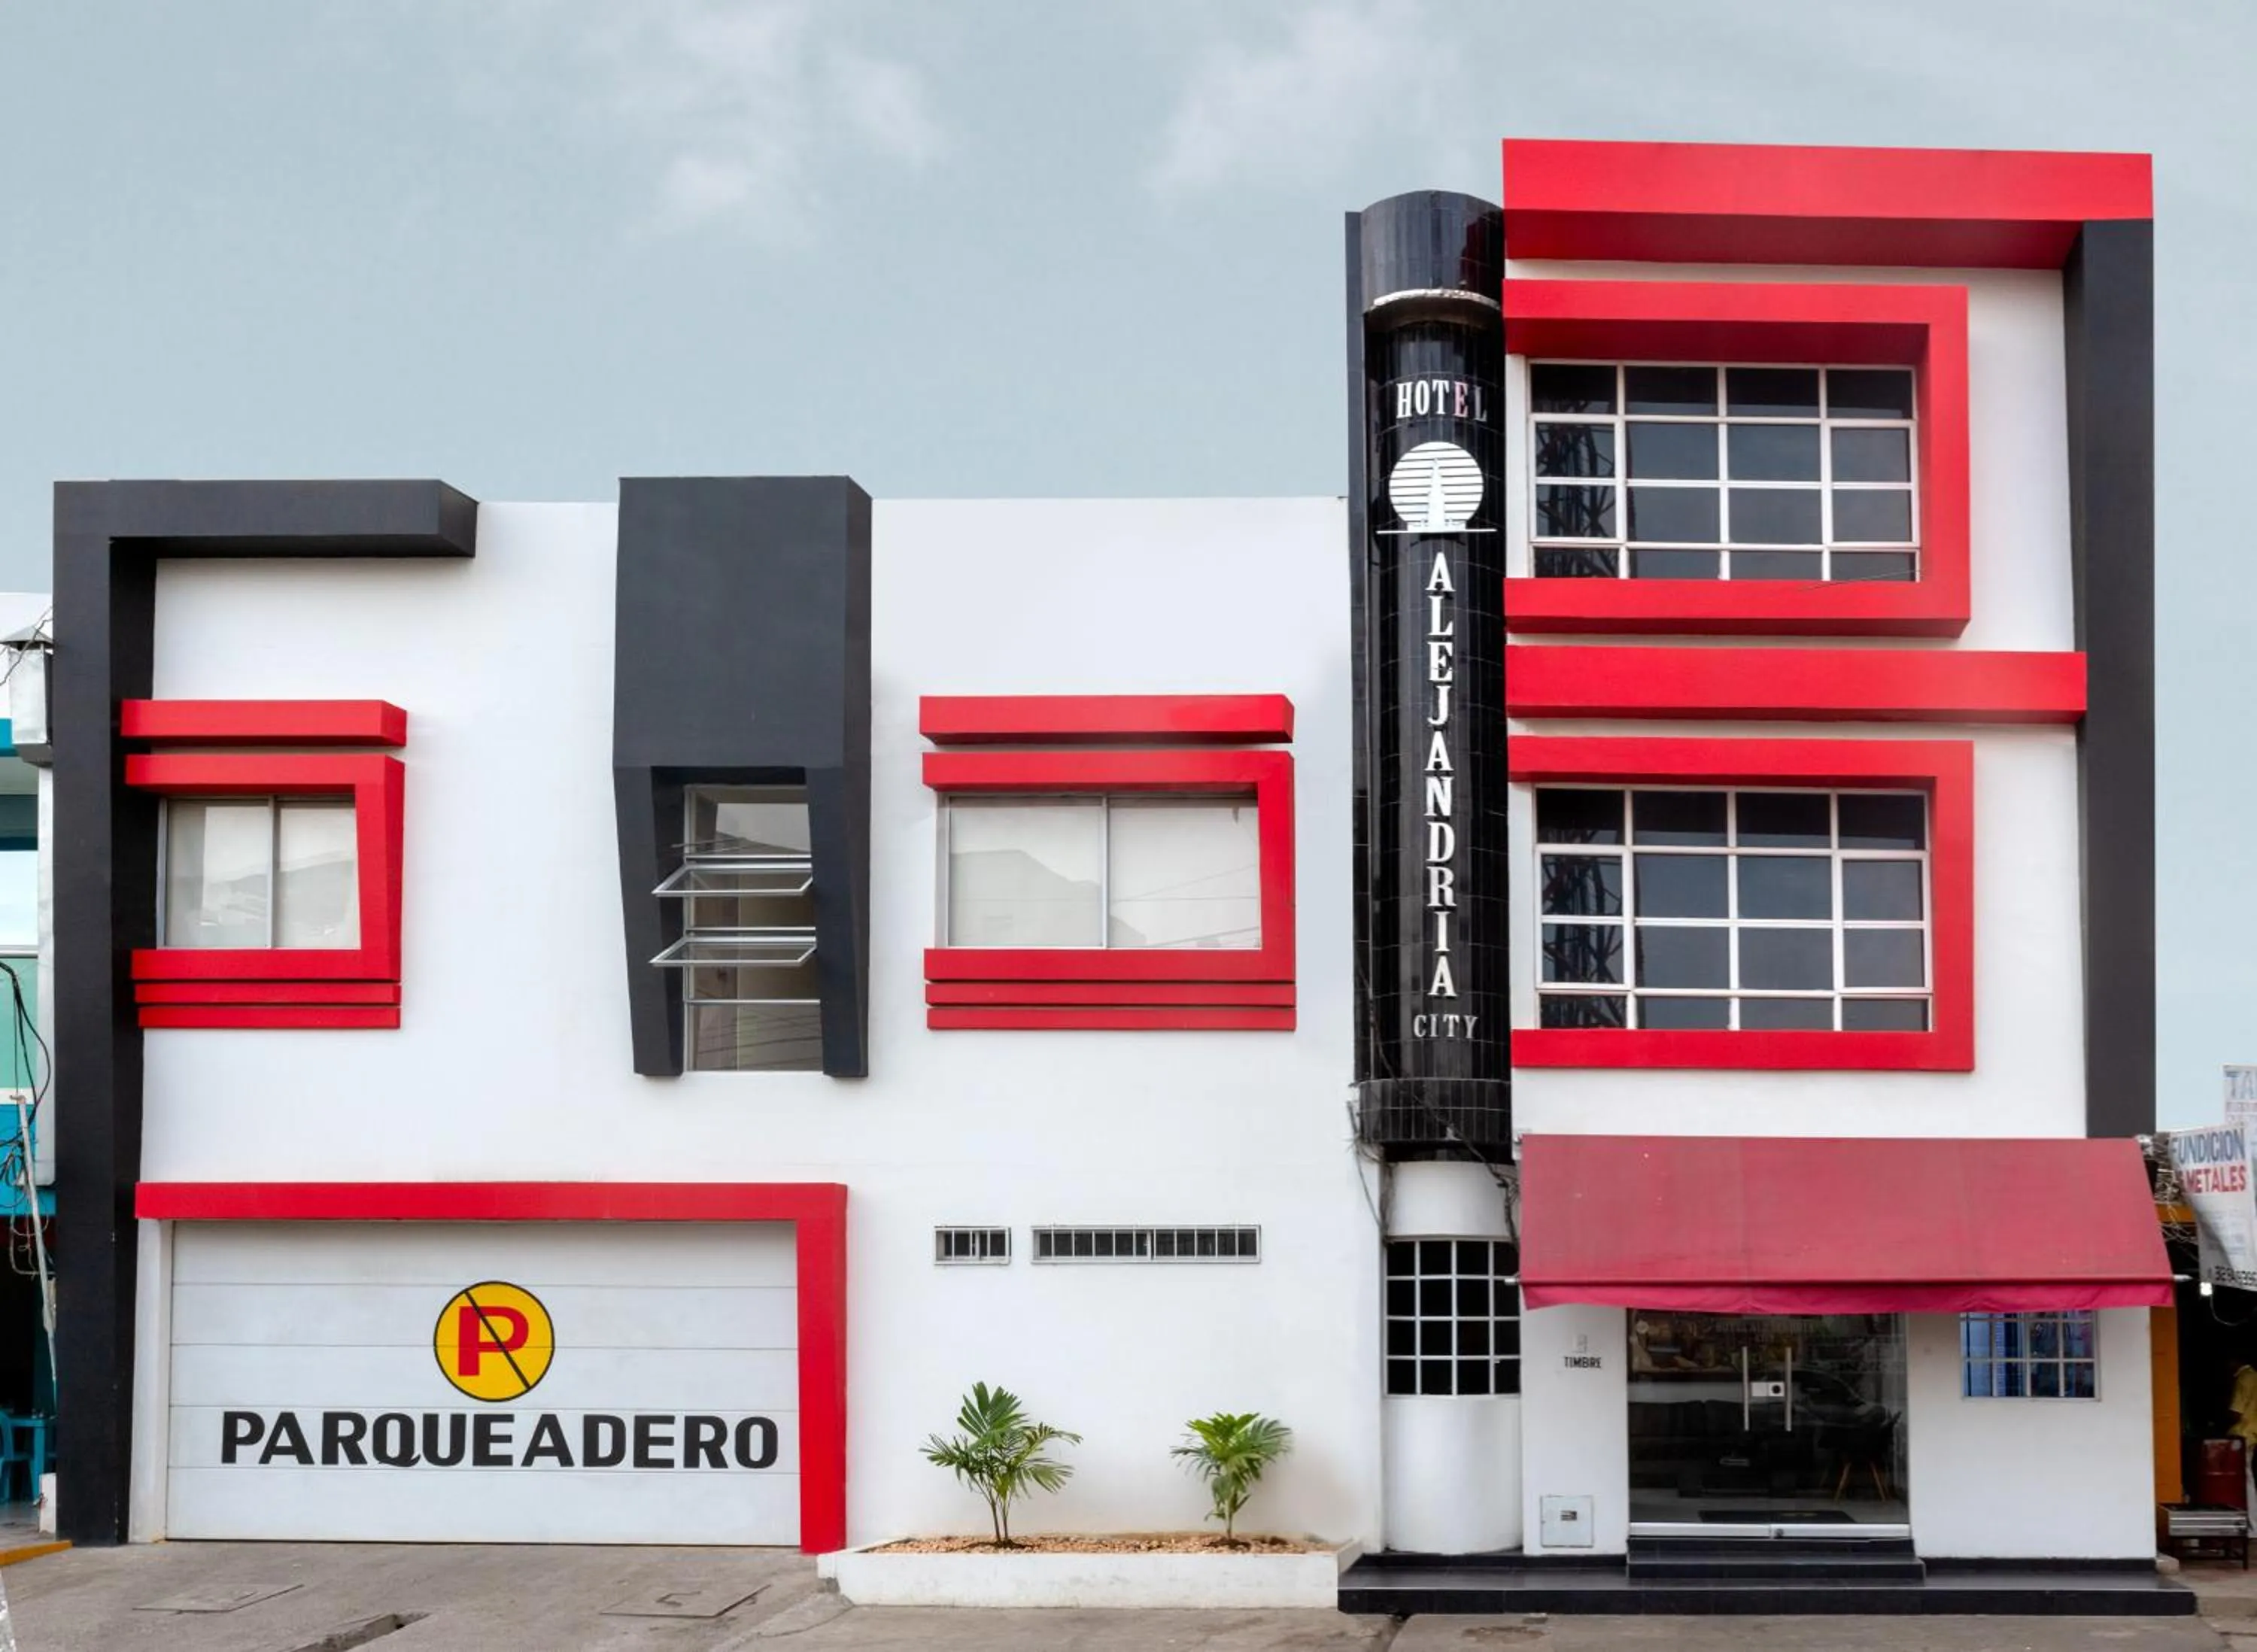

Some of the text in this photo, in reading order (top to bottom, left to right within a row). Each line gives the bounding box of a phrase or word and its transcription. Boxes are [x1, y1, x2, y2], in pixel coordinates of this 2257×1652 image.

[1396, 379, 1487, 421] HOTEL
[1425, 552, 1457, 997] ALEJANDRIA
[1414, 1013, 1478, 1038] CITY
[457, 1306, 529, 1376] P
[1564, 1356, 1601, 1368] TIMBRE
[220, 1411, 779, 1468] PARQUEADERO
